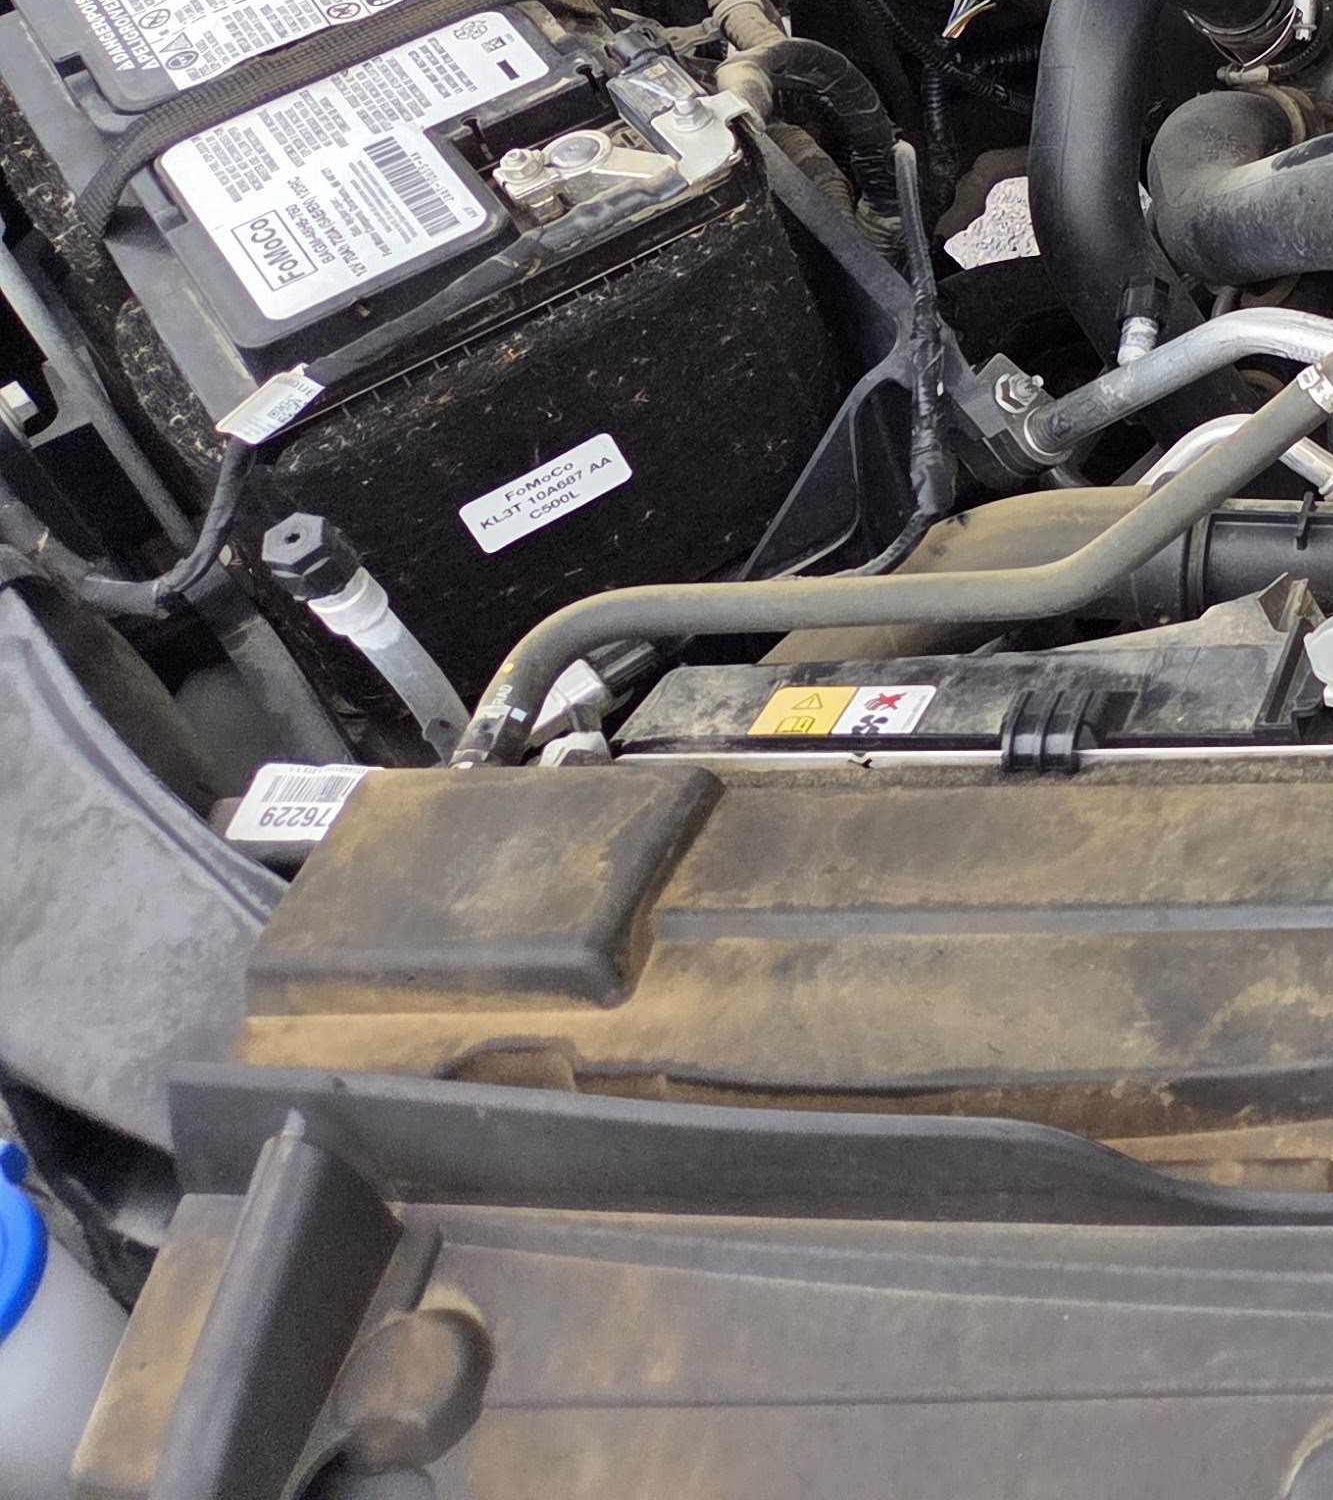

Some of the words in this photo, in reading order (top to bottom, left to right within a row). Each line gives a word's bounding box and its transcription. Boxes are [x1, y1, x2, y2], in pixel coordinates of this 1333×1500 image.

[250, 218, 305, 284] FoMoCo
[480, 503, 523, 529] KL3T
[528, 471, 583, 505] 10A687
[589, 457, 612, 473] AA
[504, 461, 573, 502] FoMoCo
[529, 490, 580, 520] C500L
[260, 807, 331, 826] 76229
